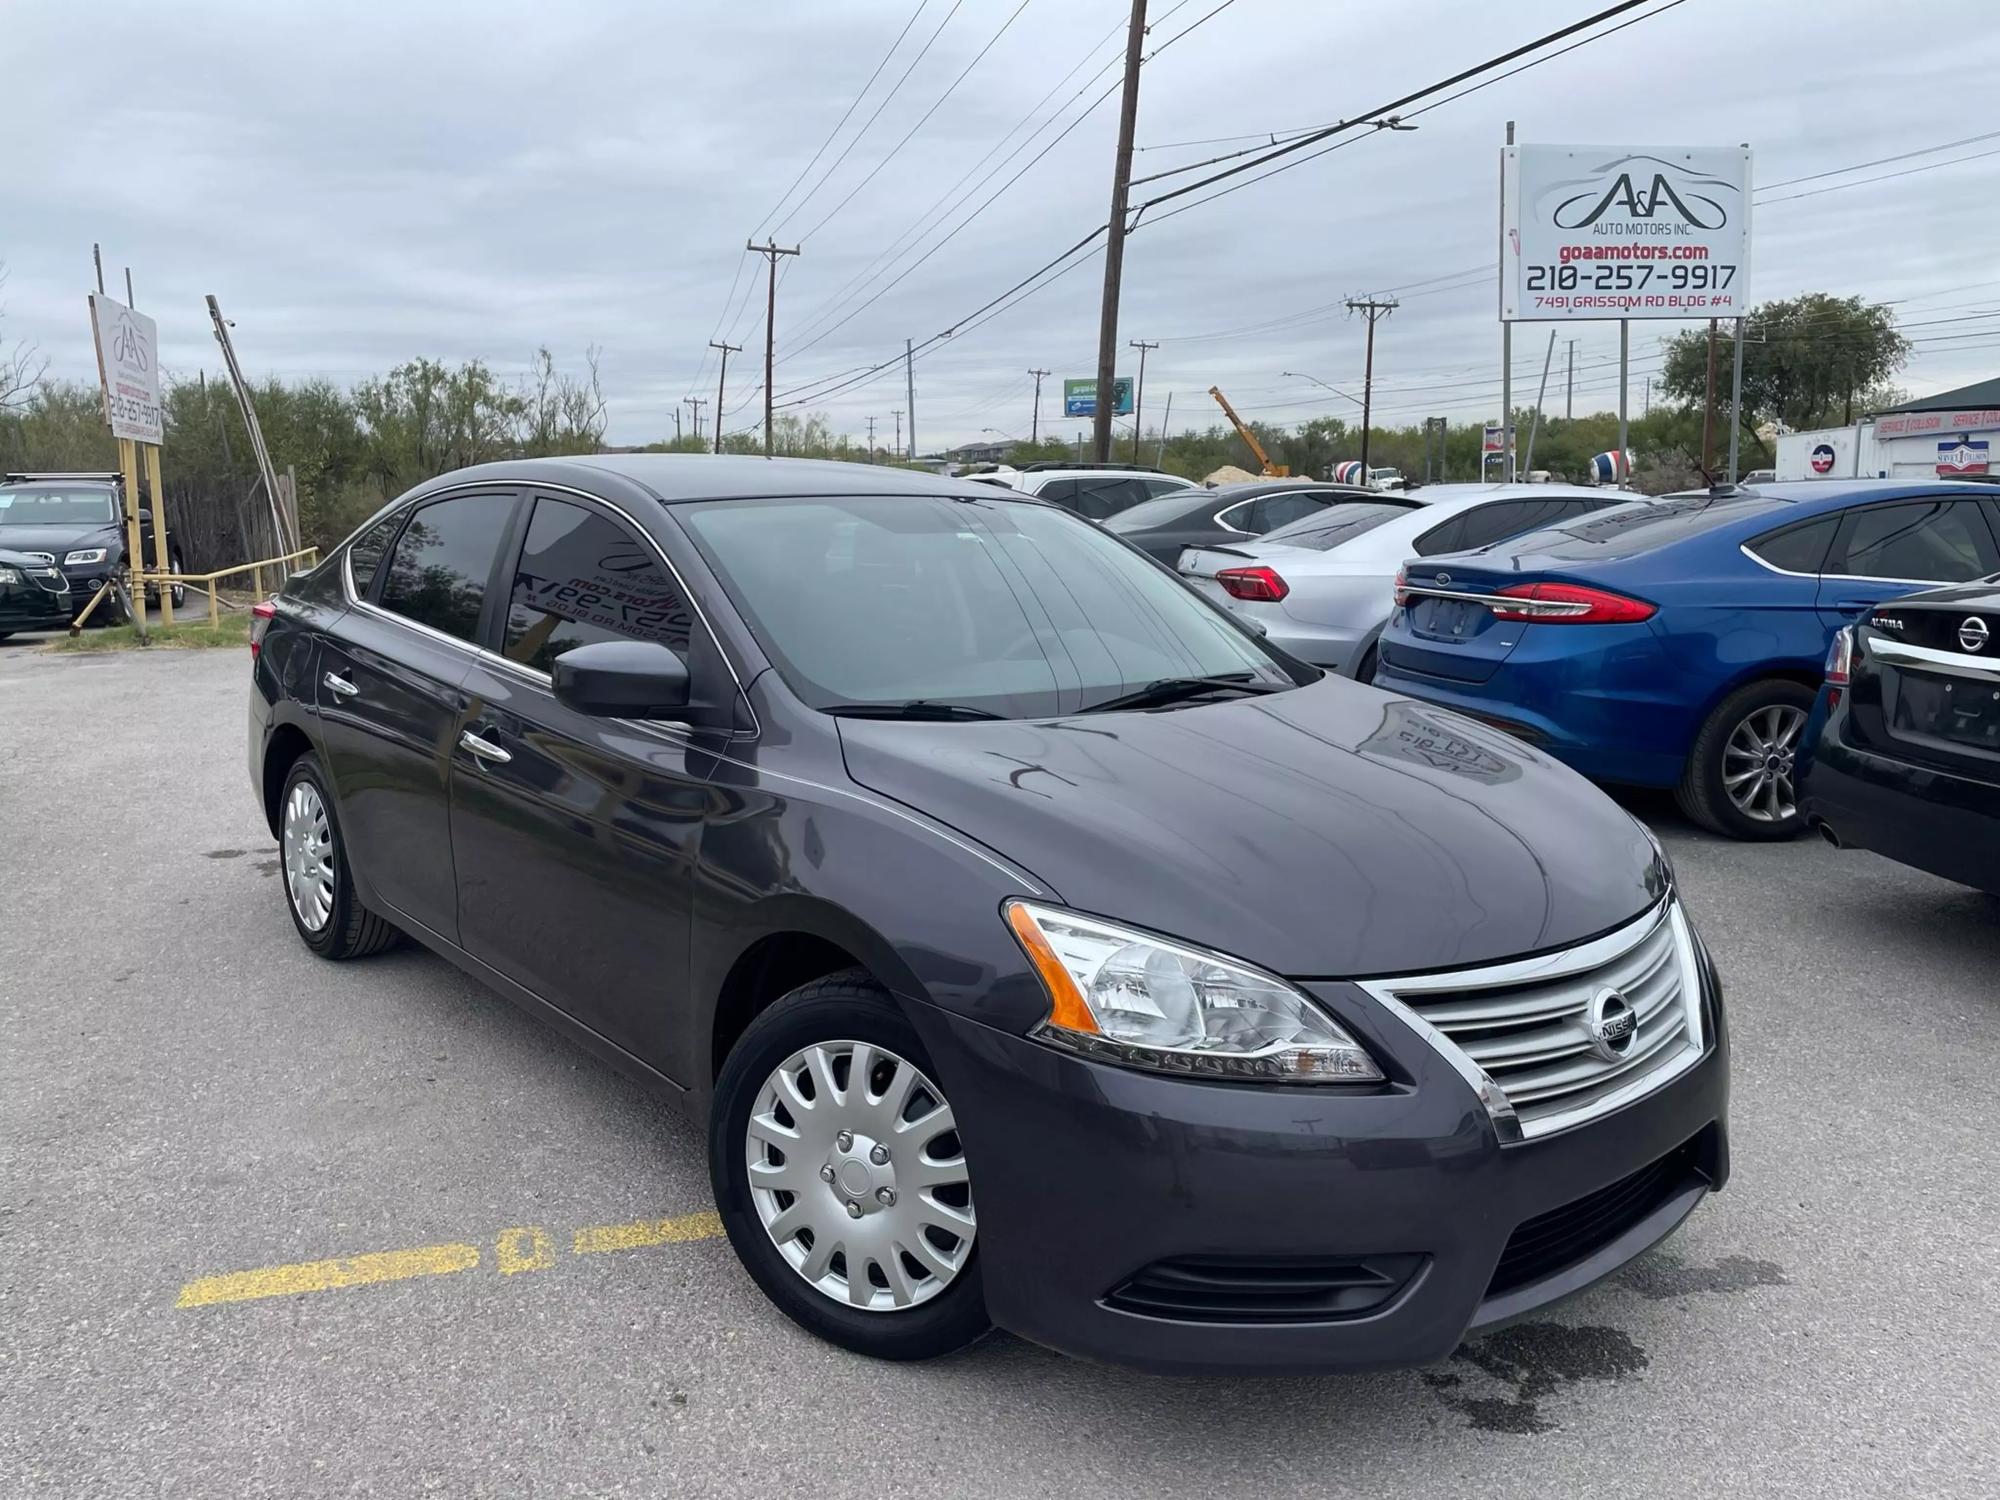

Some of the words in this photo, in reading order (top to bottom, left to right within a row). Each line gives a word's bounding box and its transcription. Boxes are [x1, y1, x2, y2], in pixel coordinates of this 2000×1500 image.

[1592, 223, 1624, 235] AUTO
[1625, 223, 1673, 235] MOTORS
[1559, 242, 1709, 264] goaamotors.com
[1526, 265, 1737, 291] 210-257-9917
[1535, 296, 1569, 308] 7491
[1573, 295, 1642, 308] GRISSOM
[1645, 295, 1665, 307] RD
[1668, 295, 1706, 307] BLDG
[1710, 295, 1732, 307] #4
